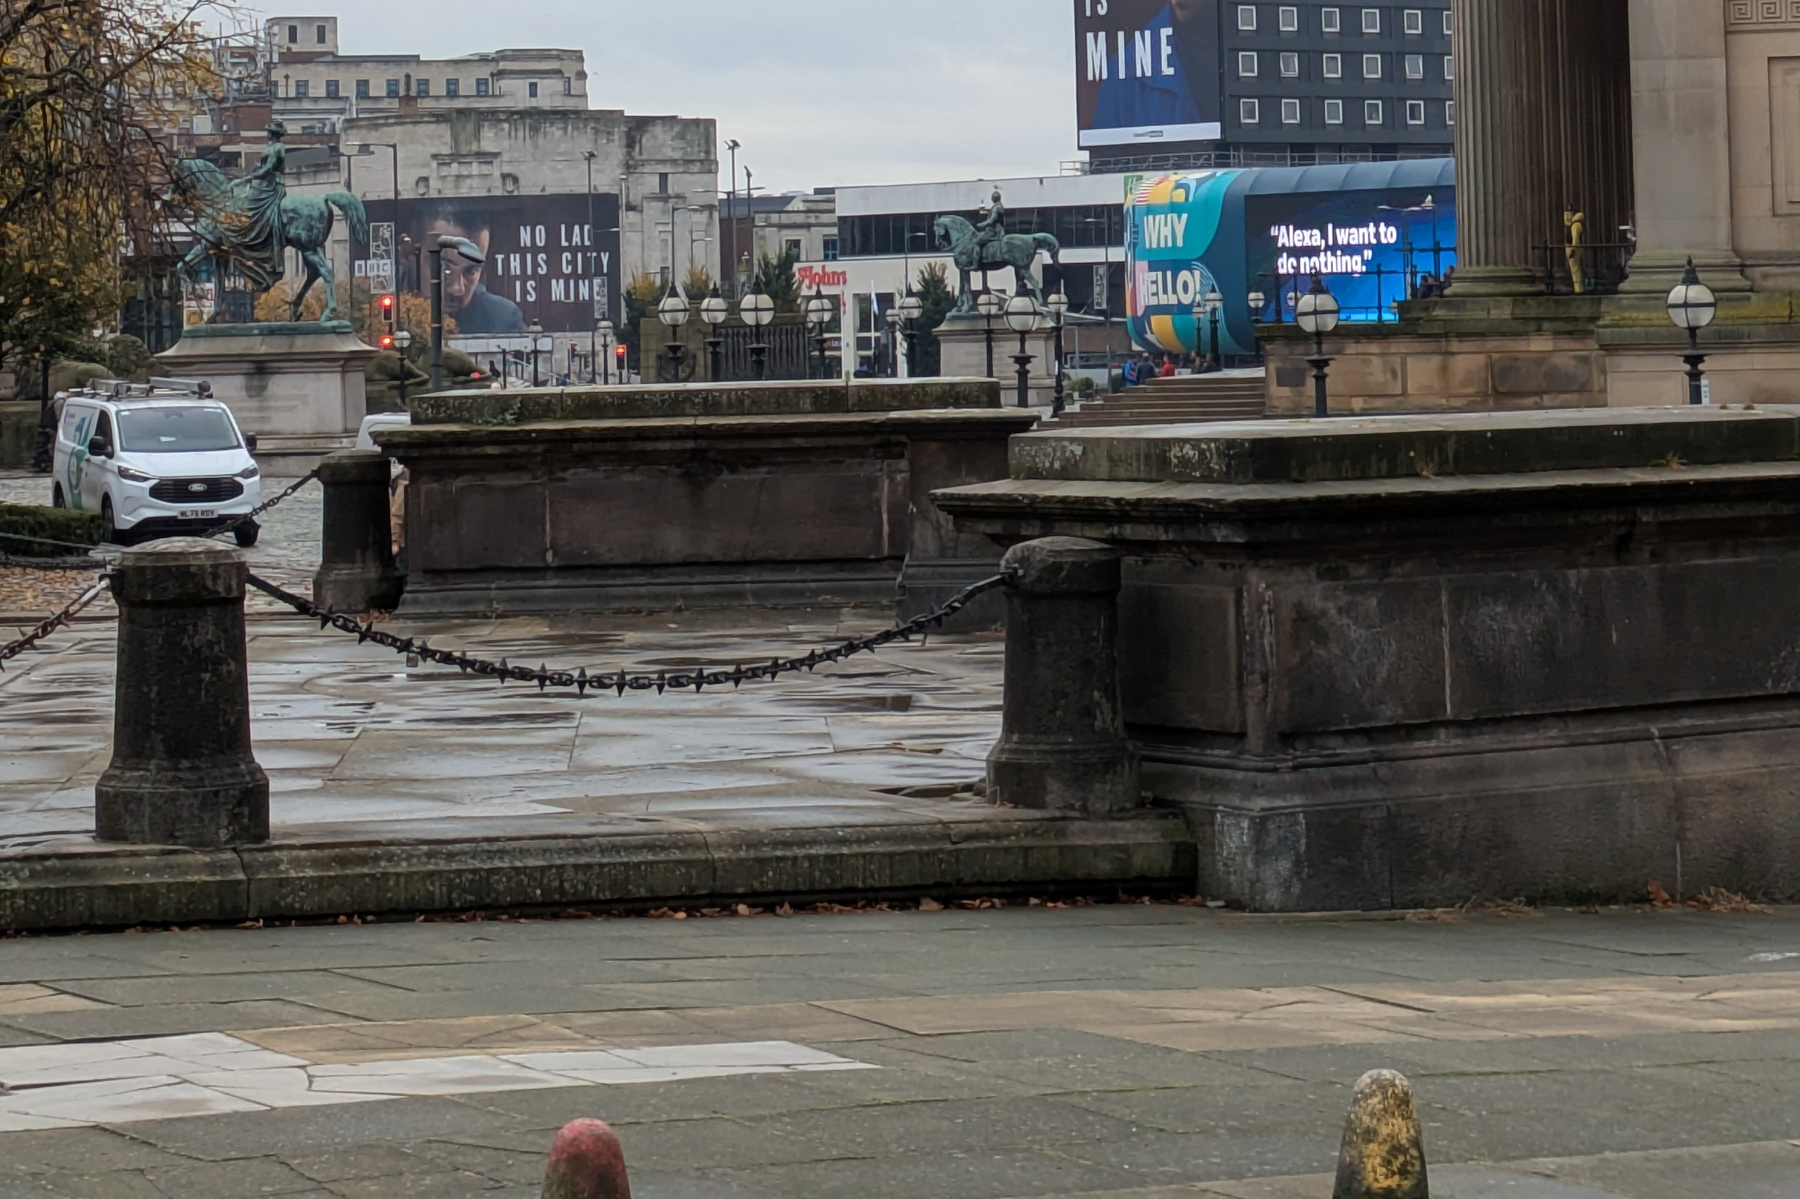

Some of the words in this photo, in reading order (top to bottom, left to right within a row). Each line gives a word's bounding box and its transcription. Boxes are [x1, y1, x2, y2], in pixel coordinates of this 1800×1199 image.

[1086, 27, 1175, 81] MINE
[520, 224, 546, 247] NO
[1144, 213, 1188, 249] WHY
[1271, 224, 1325, 250] “Alexa,
[1327, 222, 1333, 246] I
[1335, 222, 1377, 245] want
[1379, 222, 1397, 244] to
[495, 253, 547, 275] THIS
[515, 280, 537, 302] IS
[1139, 270, 1200, 305] HELLO!
